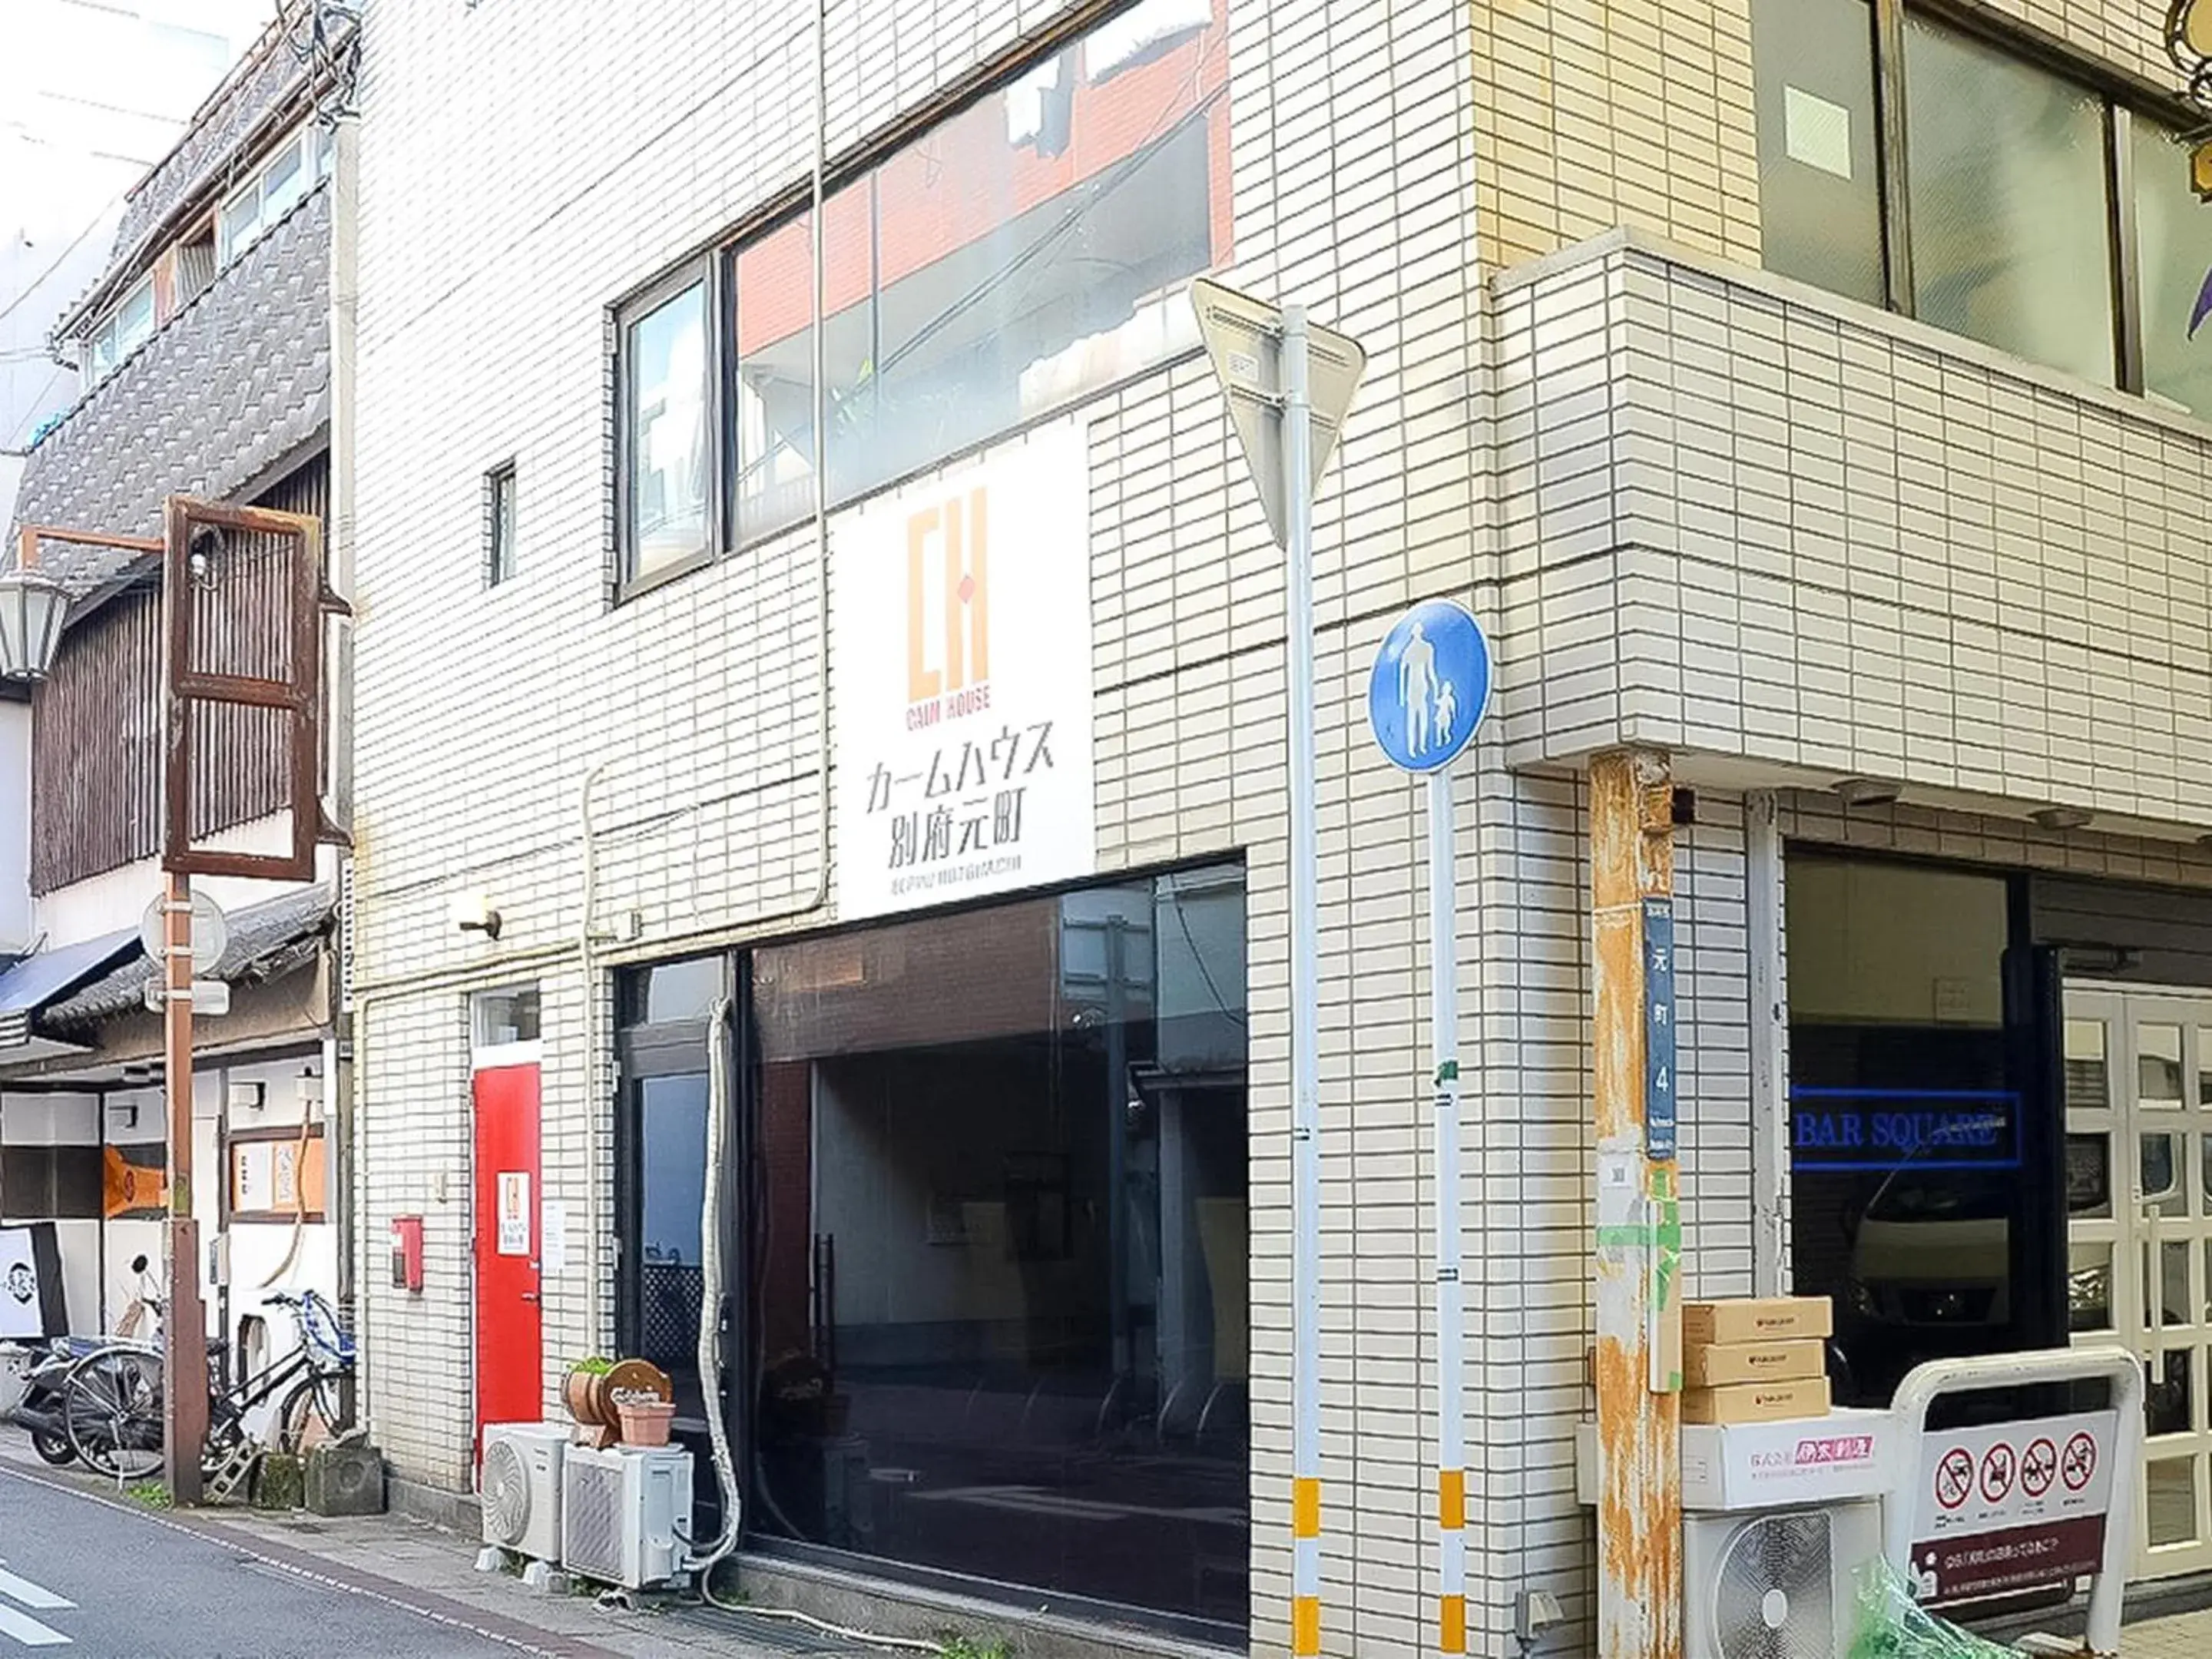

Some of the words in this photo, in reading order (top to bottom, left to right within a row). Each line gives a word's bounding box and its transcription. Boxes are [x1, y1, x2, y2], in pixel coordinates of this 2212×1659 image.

[946, 684, 990, 720] HOUSE
[866, 720, 1054, 814] カームハウス
[888, 786, 1027, 869] 別府元町
[1793, 1112, 1863, 1147] BAR
[1871, 1112, 1998, 1154] SQUARE
